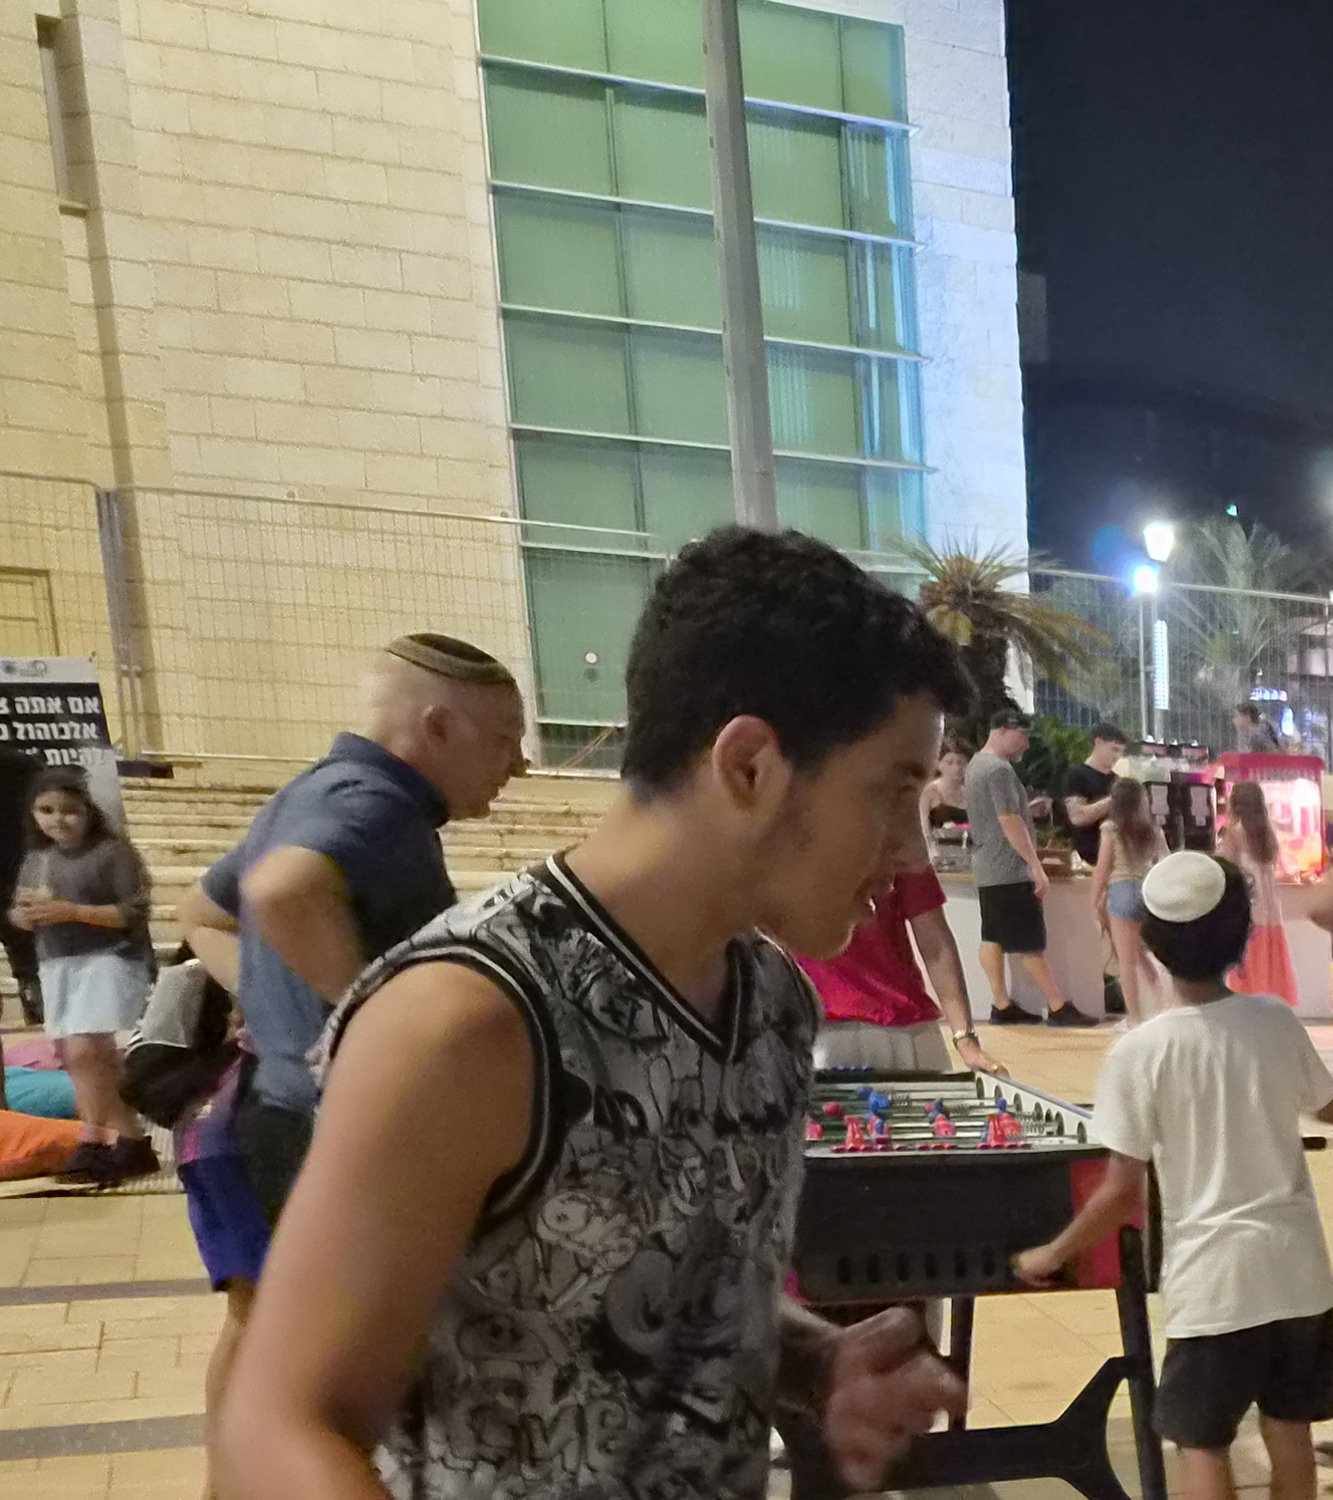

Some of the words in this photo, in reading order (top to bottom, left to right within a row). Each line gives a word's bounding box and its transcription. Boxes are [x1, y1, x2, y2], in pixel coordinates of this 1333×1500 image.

[14, 696, 64, 714] אתה
[66, 696, 101, 714] אם
[12, 721, 100, 741] אלכוהול
